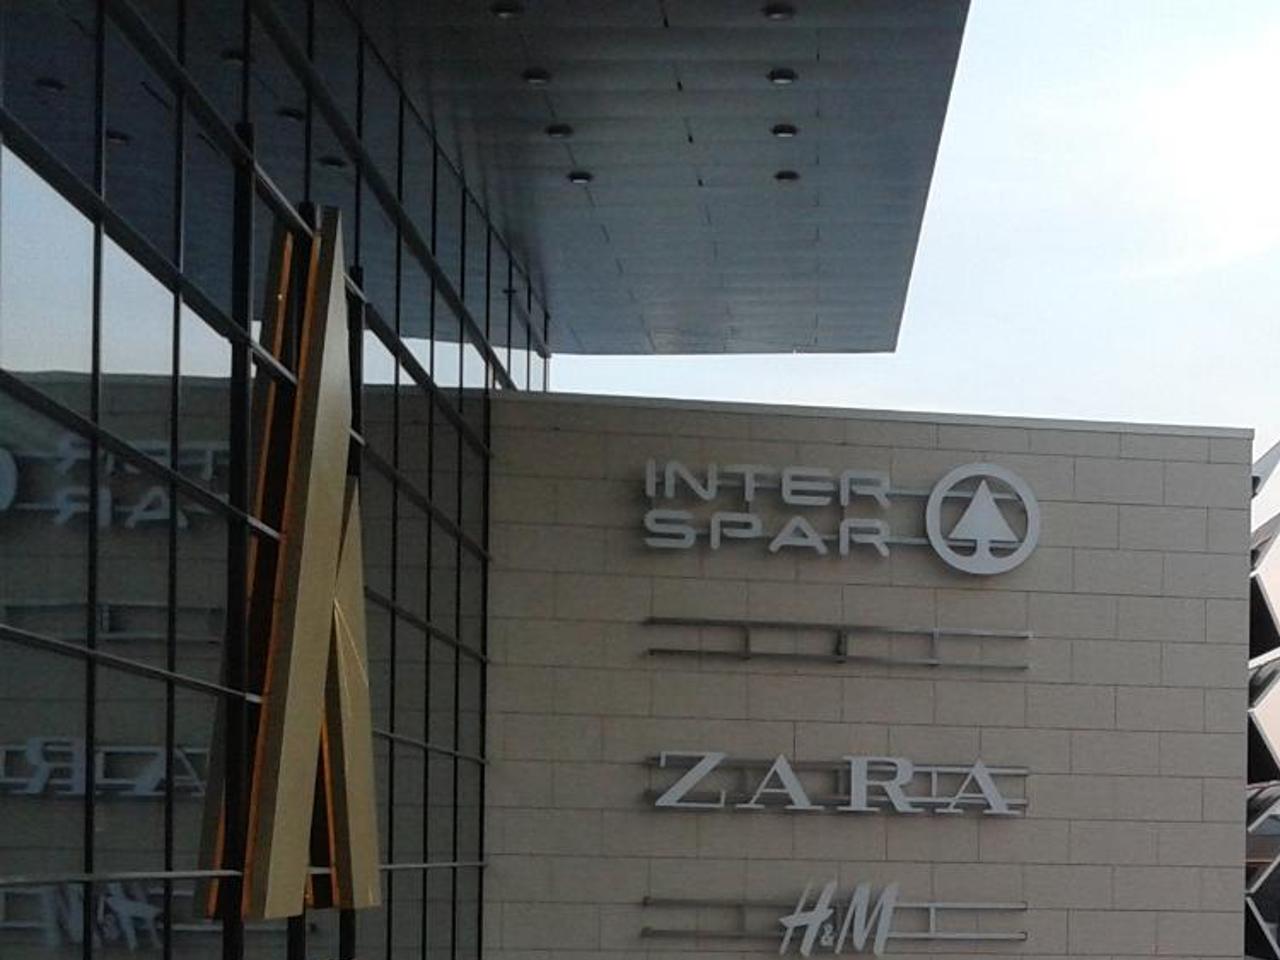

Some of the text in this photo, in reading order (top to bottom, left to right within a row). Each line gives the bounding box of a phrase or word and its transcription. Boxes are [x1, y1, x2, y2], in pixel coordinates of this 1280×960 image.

[645, 459, 891, 507] INTER
[644, 509, 890, 557] SPAR
[655, 752, 1022, 814] ZARA
[779, 877, 899, 957] H&M
